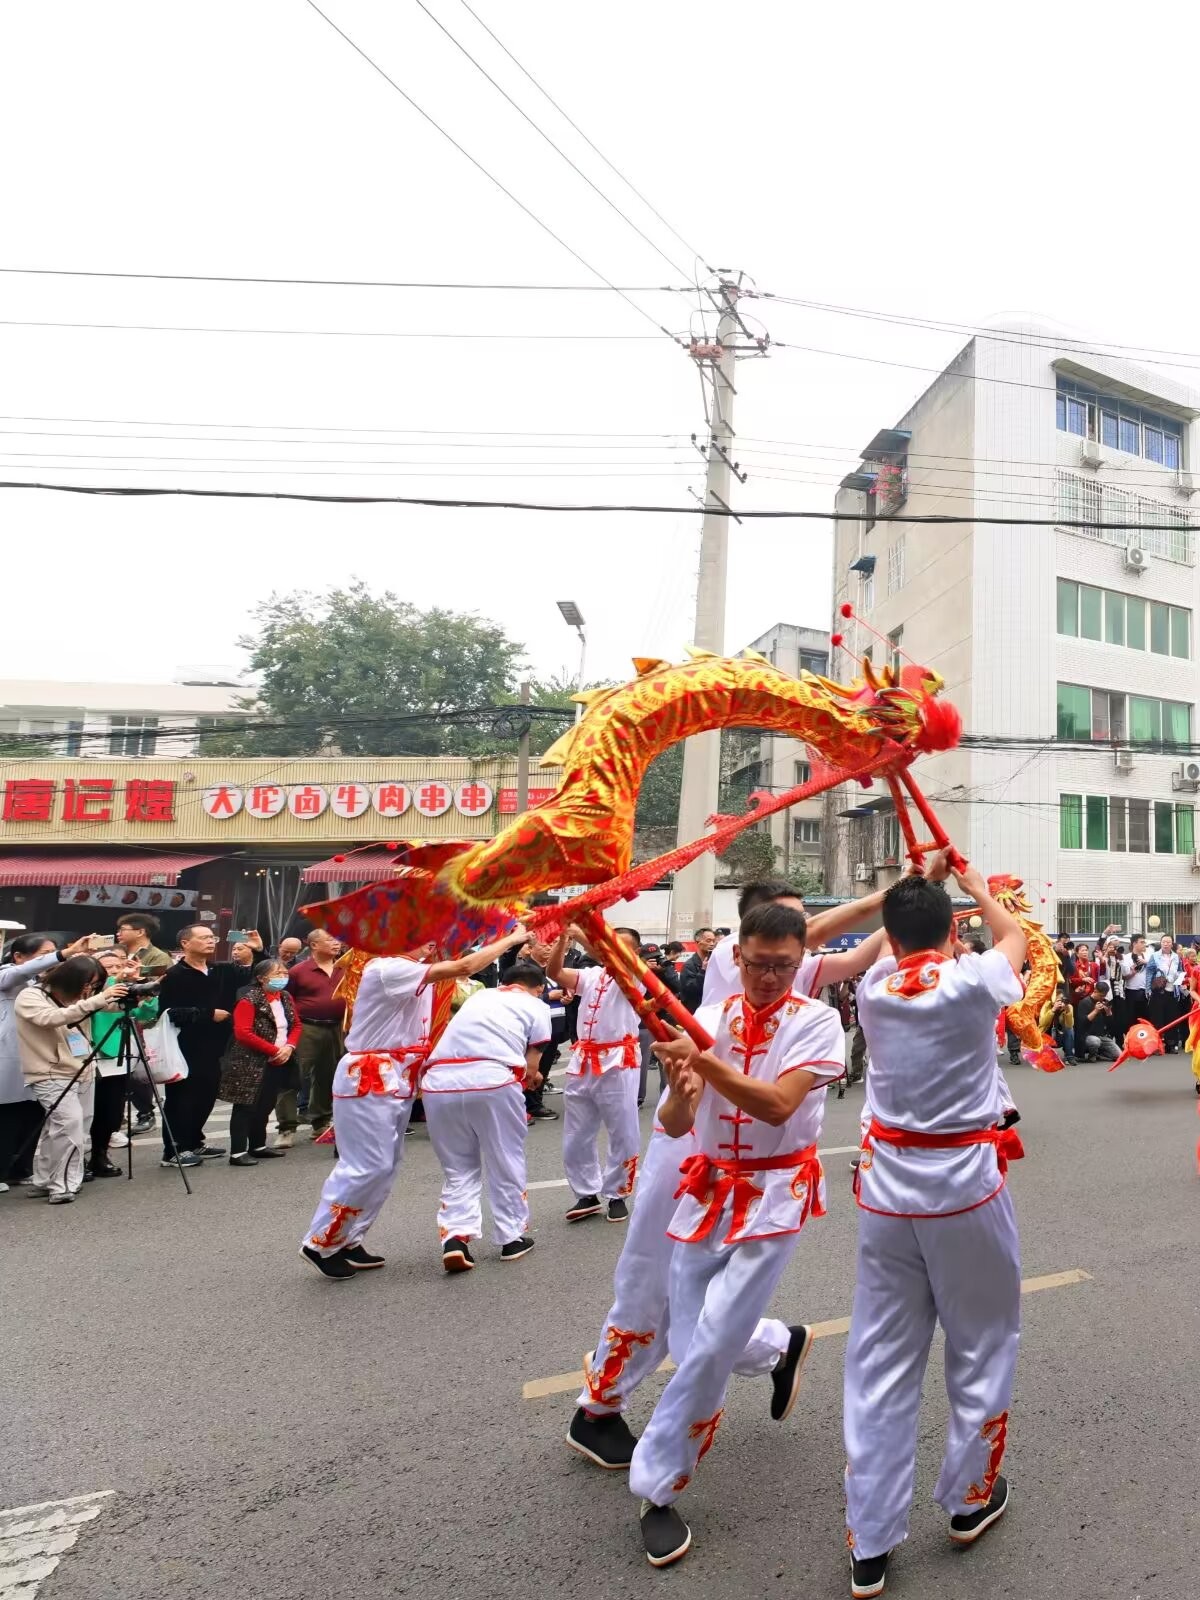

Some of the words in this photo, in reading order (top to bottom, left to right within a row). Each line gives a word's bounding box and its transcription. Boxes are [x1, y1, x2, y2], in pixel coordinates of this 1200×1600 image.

[2, 779, 174, 822] 唐记煌
[209, 784, 486, 814] 大坨卤牛肉串串
